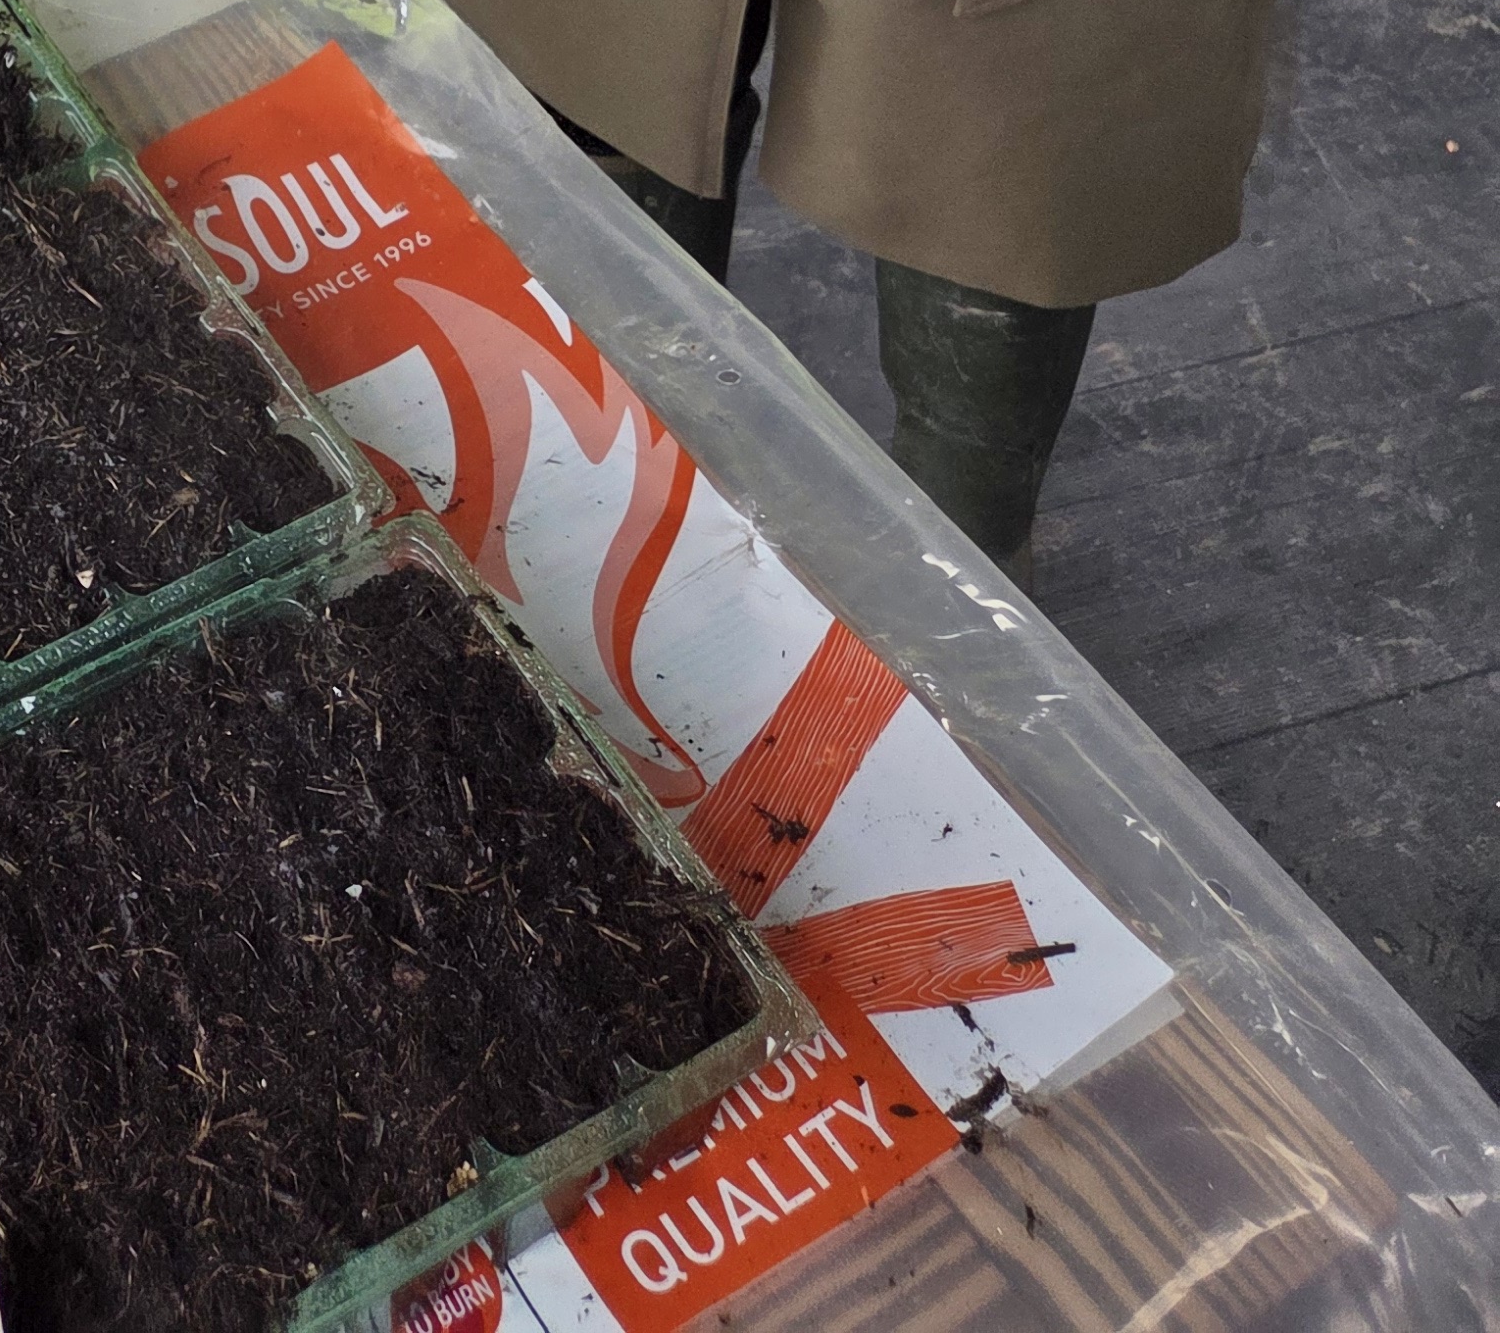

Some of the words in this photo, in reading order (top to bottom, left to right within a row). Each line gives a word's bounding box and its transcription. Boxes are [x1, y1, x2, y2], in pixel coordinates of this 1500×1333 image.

[194, 153, 409, 295] SOUL
[292, 262, 372, 310] SINCE
[373, 230, 432, 268] 1996
[621, 1079, 895, 1293] QUALITY
[428, 1273, 495, 1328] BURN
